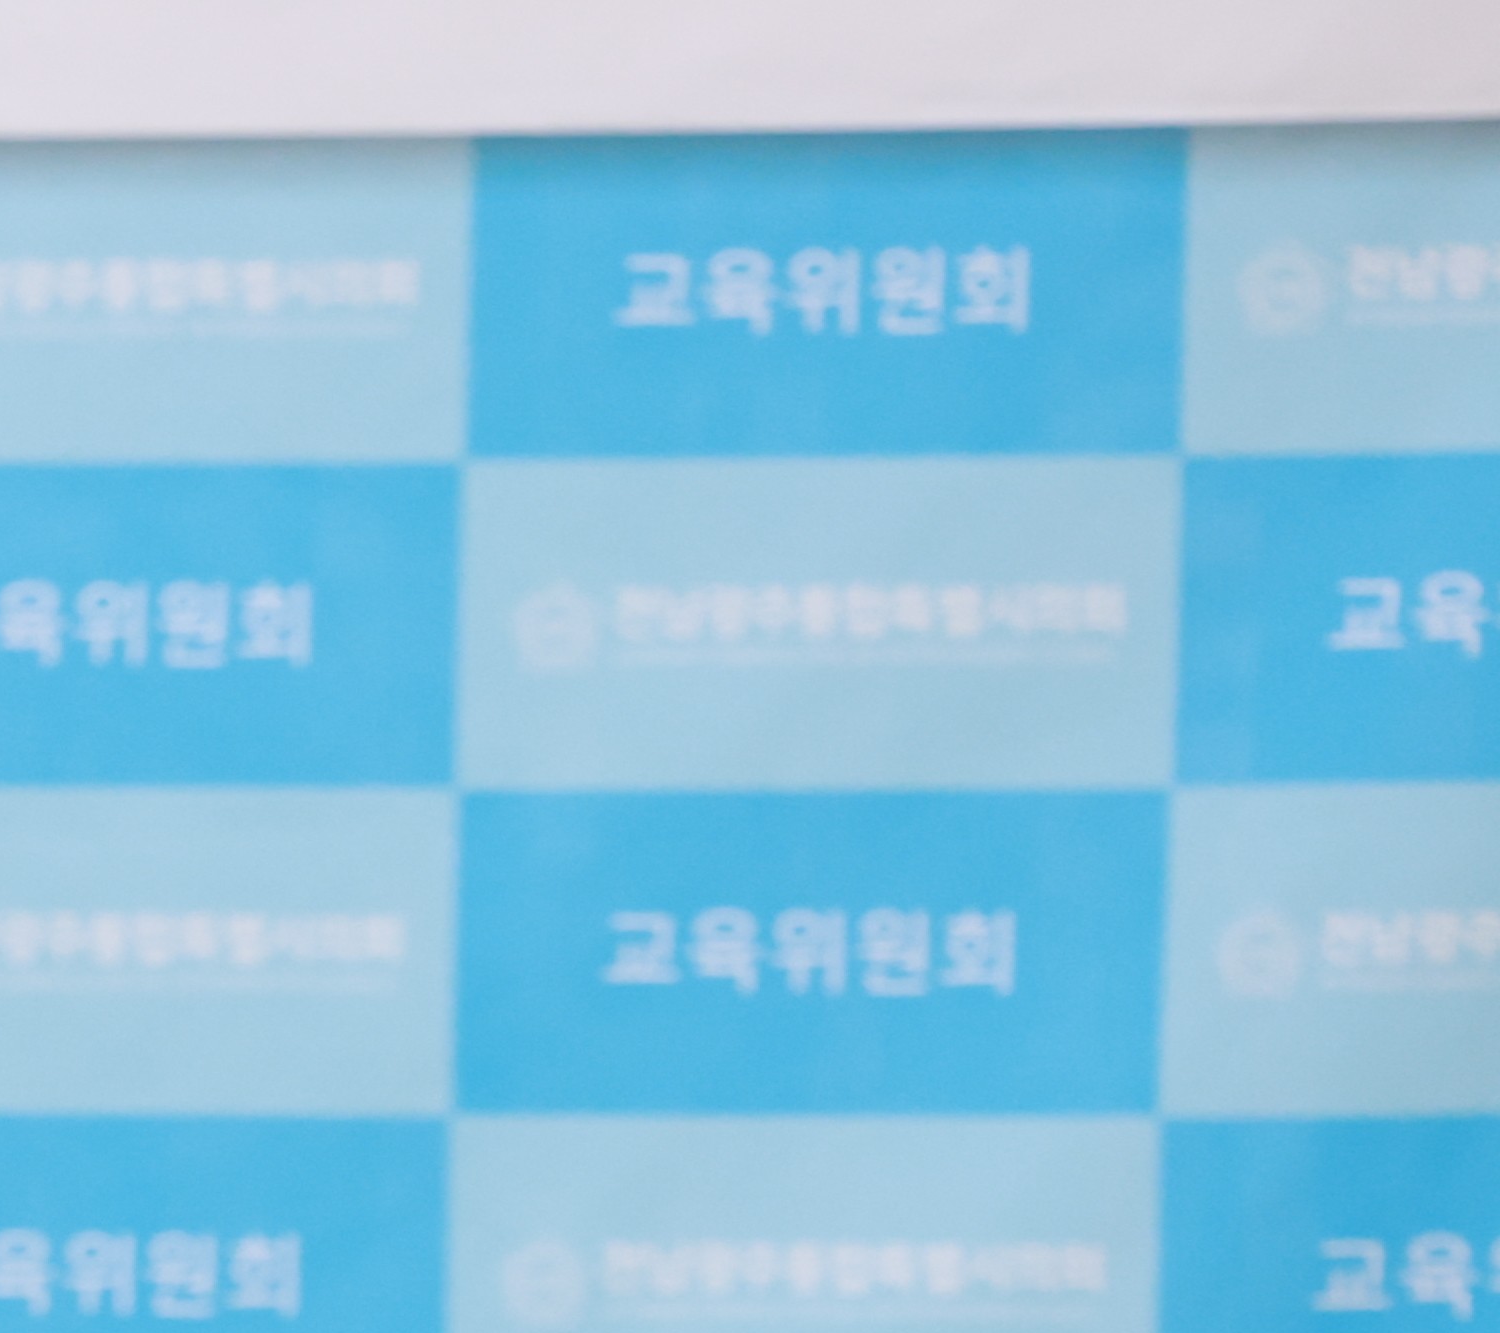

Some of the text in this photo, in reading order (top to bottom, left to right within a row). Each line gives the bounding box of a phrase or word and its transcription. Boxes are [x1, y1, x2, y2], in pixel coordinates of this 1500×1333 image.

[614, 244, 1033, 339] 교육위원회
[1326, 568, 1500, 662] 교육
[603, 904, 1019, 999] 교육위원회
[1310, 1230, 1500, 1323] 교육
